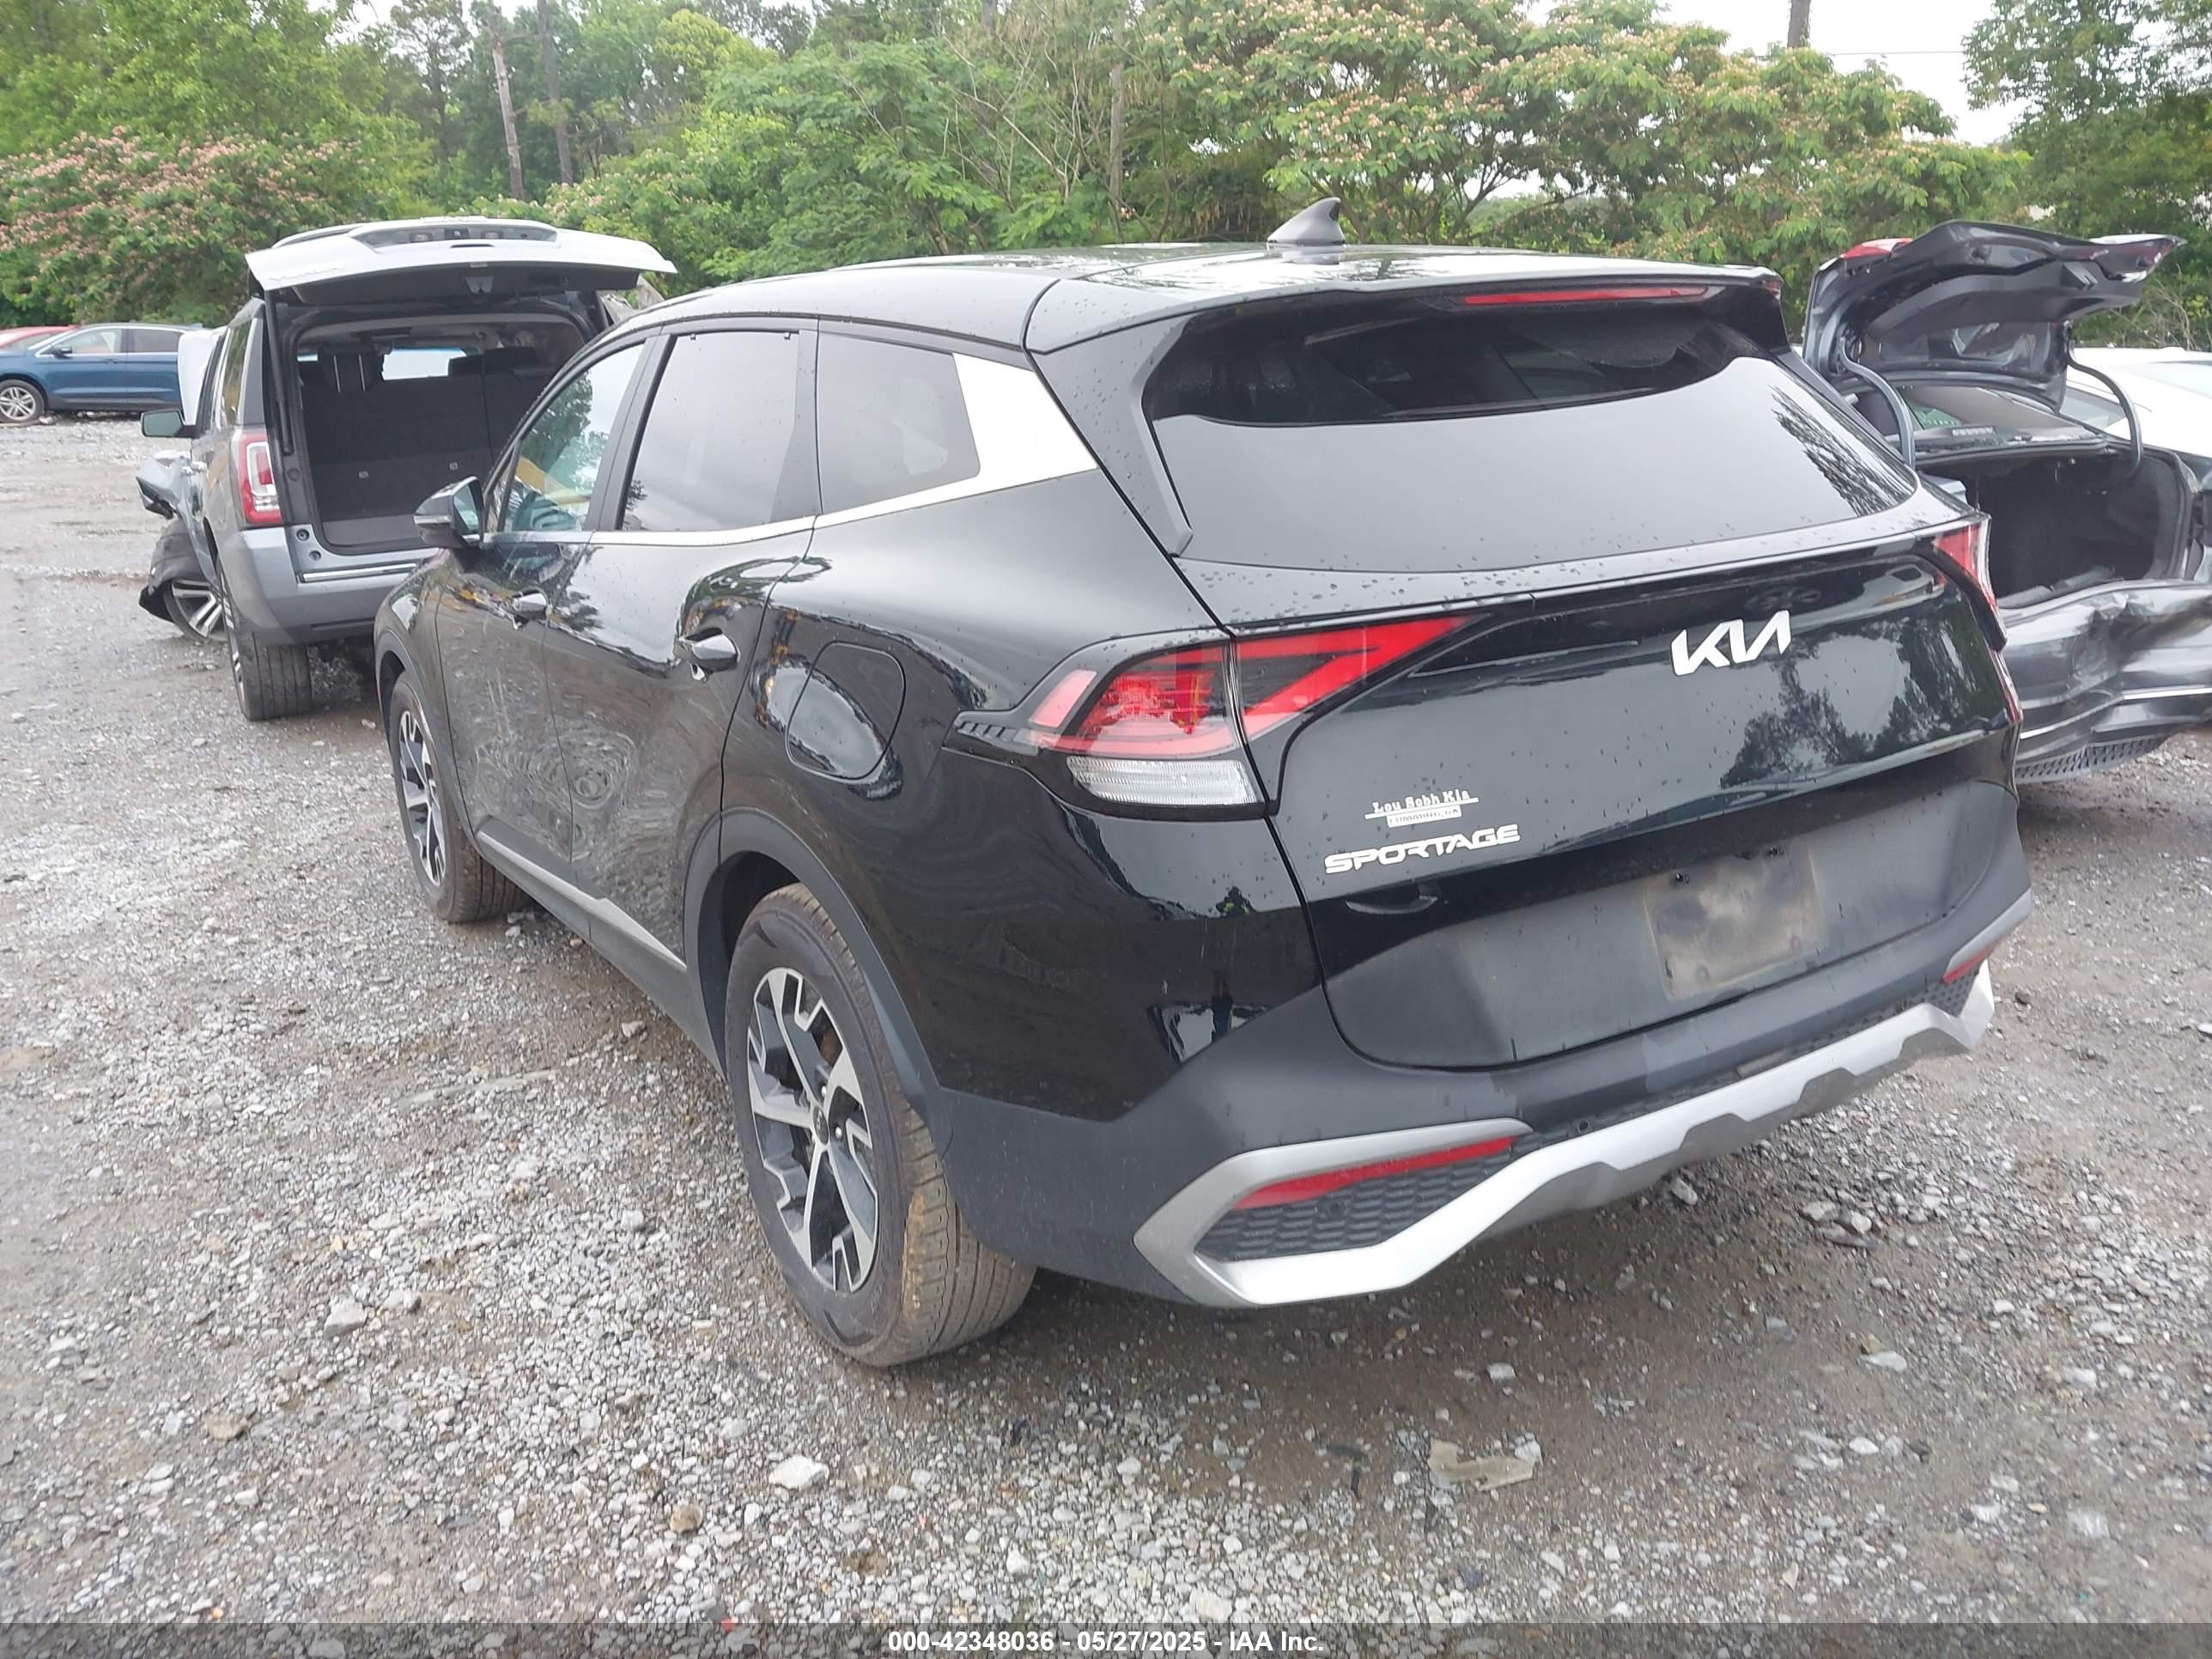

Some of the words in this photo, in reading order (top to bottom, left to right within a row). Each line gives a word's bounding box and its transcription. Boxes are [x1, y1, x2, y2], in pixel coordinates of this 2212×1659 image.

[1670, 609, 1792, 677] KIA
[1372, 801, 1402, 814] Lou
[1324, 823, 1521, 874] SPORTAGE
